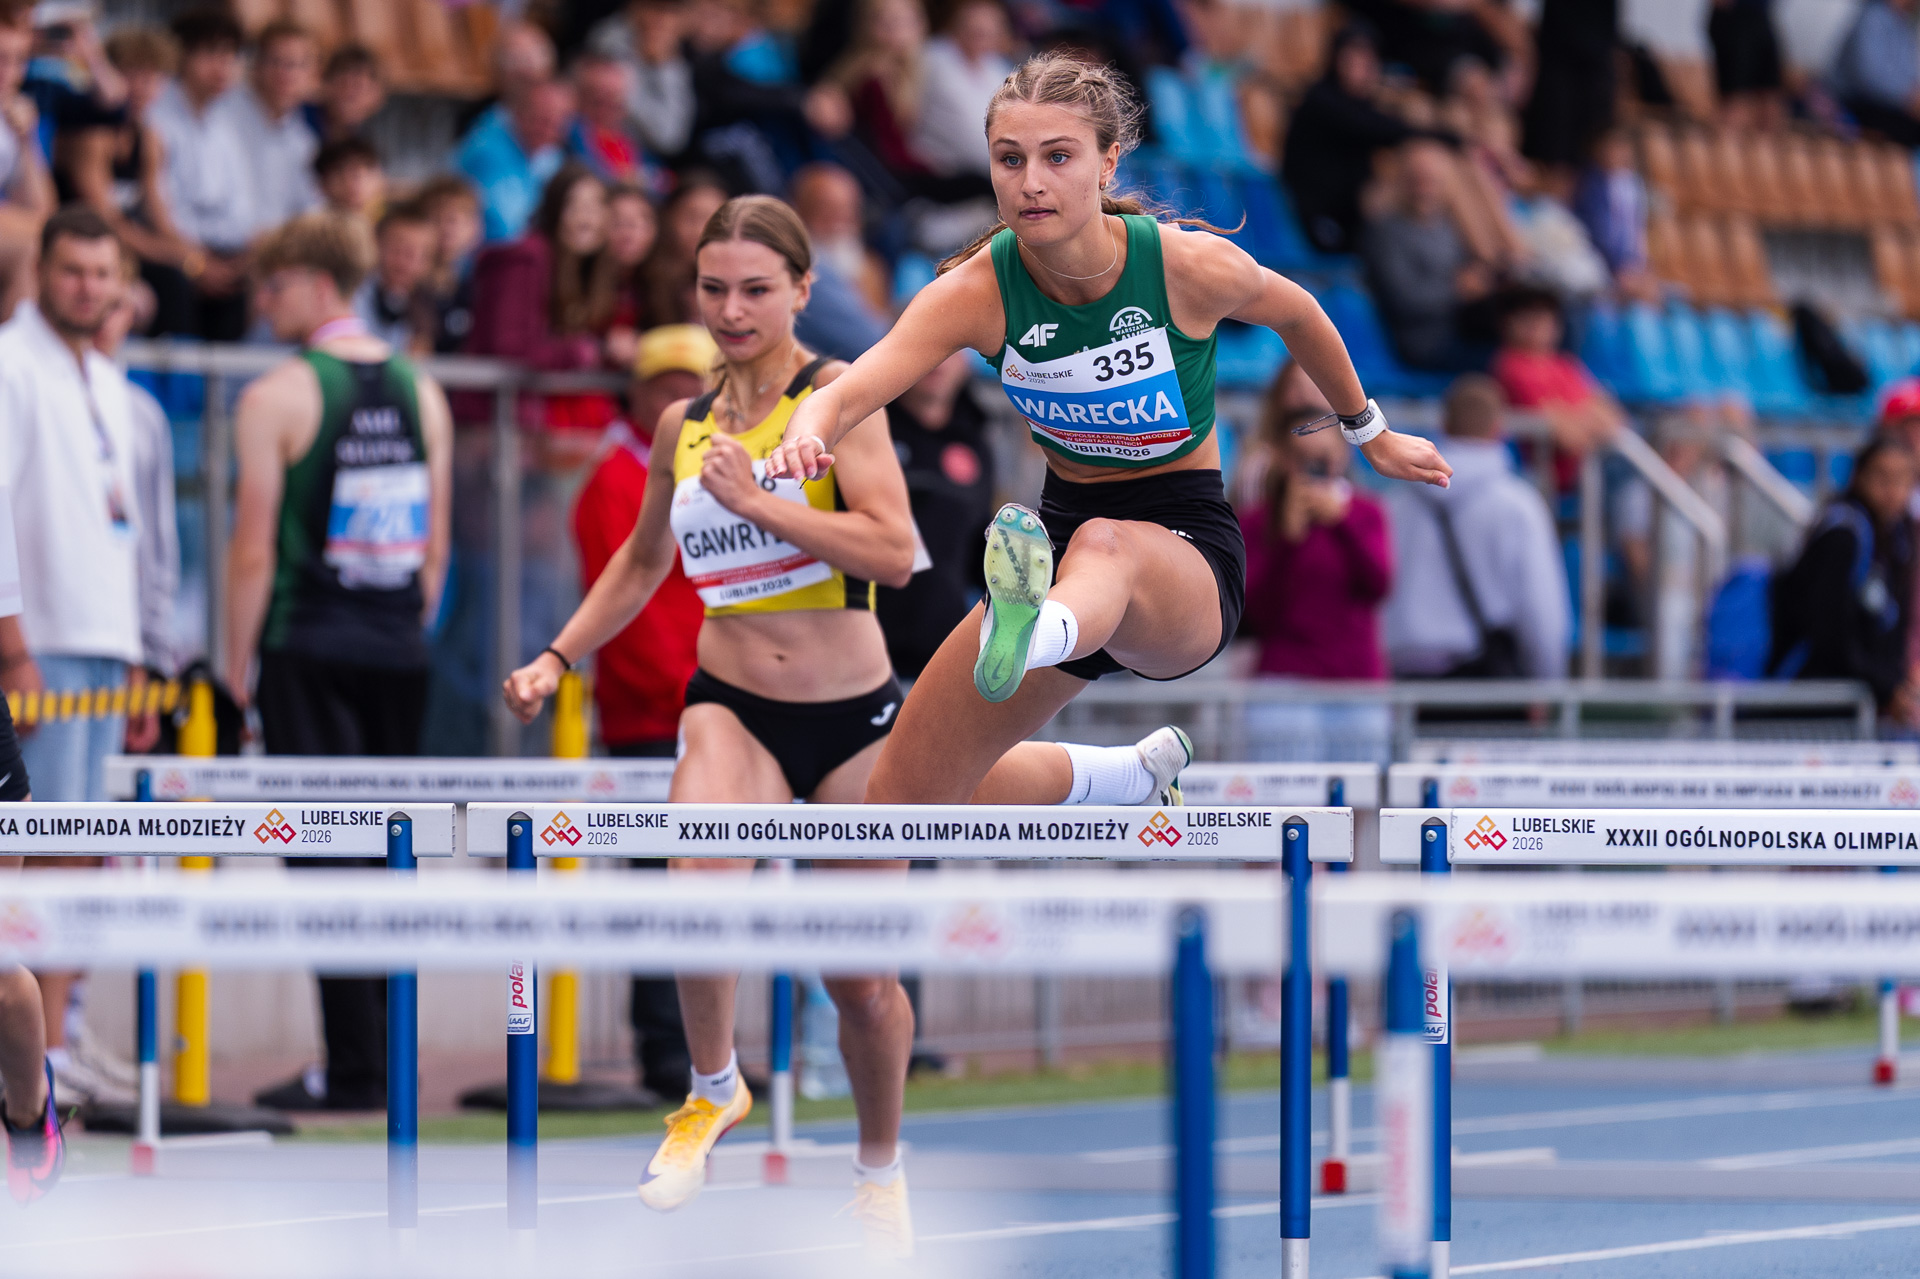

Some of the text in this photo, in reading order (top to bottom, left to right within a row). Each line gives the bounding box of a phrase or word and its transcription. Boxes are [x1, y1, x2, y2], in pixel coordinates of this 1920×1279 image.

[1118, 312, 1143, 329] AZS
[1019, 323, 1059, 347] 4F
[1115, 323, 1149, 335] WARSZAWA
[1092, 341, 1155, 382] 335
[1025, 369, 1074, 379] LUBELSKIE
[1028, 377, 1046, 385] 2026
[1012, 390, 1179, 425] WARECKA
[1062, 441, 1151, 457] LUBLIN 2026
[683, 522, 783, 559] GAWRY
[719, 585, 758, 600] LUBLIN
[761, 576, 793, 592] 2026
[26, 818, 131, 836] OLIMPIADA
[139, 815, 246, 837] MŁODZIEŻY
[301, 810, 383, 826] LUBELSKIE
[587, 813, 669, 828] LUBELSKIE
[1187, 812, 1272, 828] LUBELSKIE
[1512, 817, 1596, 834] LUBELSKIE
[301, 830, 332, 844] 2026
[678, 818, 1130, 841] XXXII OGÓLNOPOLSKA OLIMPIADA MŁODZIEŻY
[587, 832, 618, 845] 2026
[1187, 832, 1219, 846] 2026
[1512, 836, 1544, 851] 2026
[1605, 826, 1919, 850] XXXII OGÓLNOPOLSKA OLIMPIA
[509, 1017, 530, 1025] IAAF
